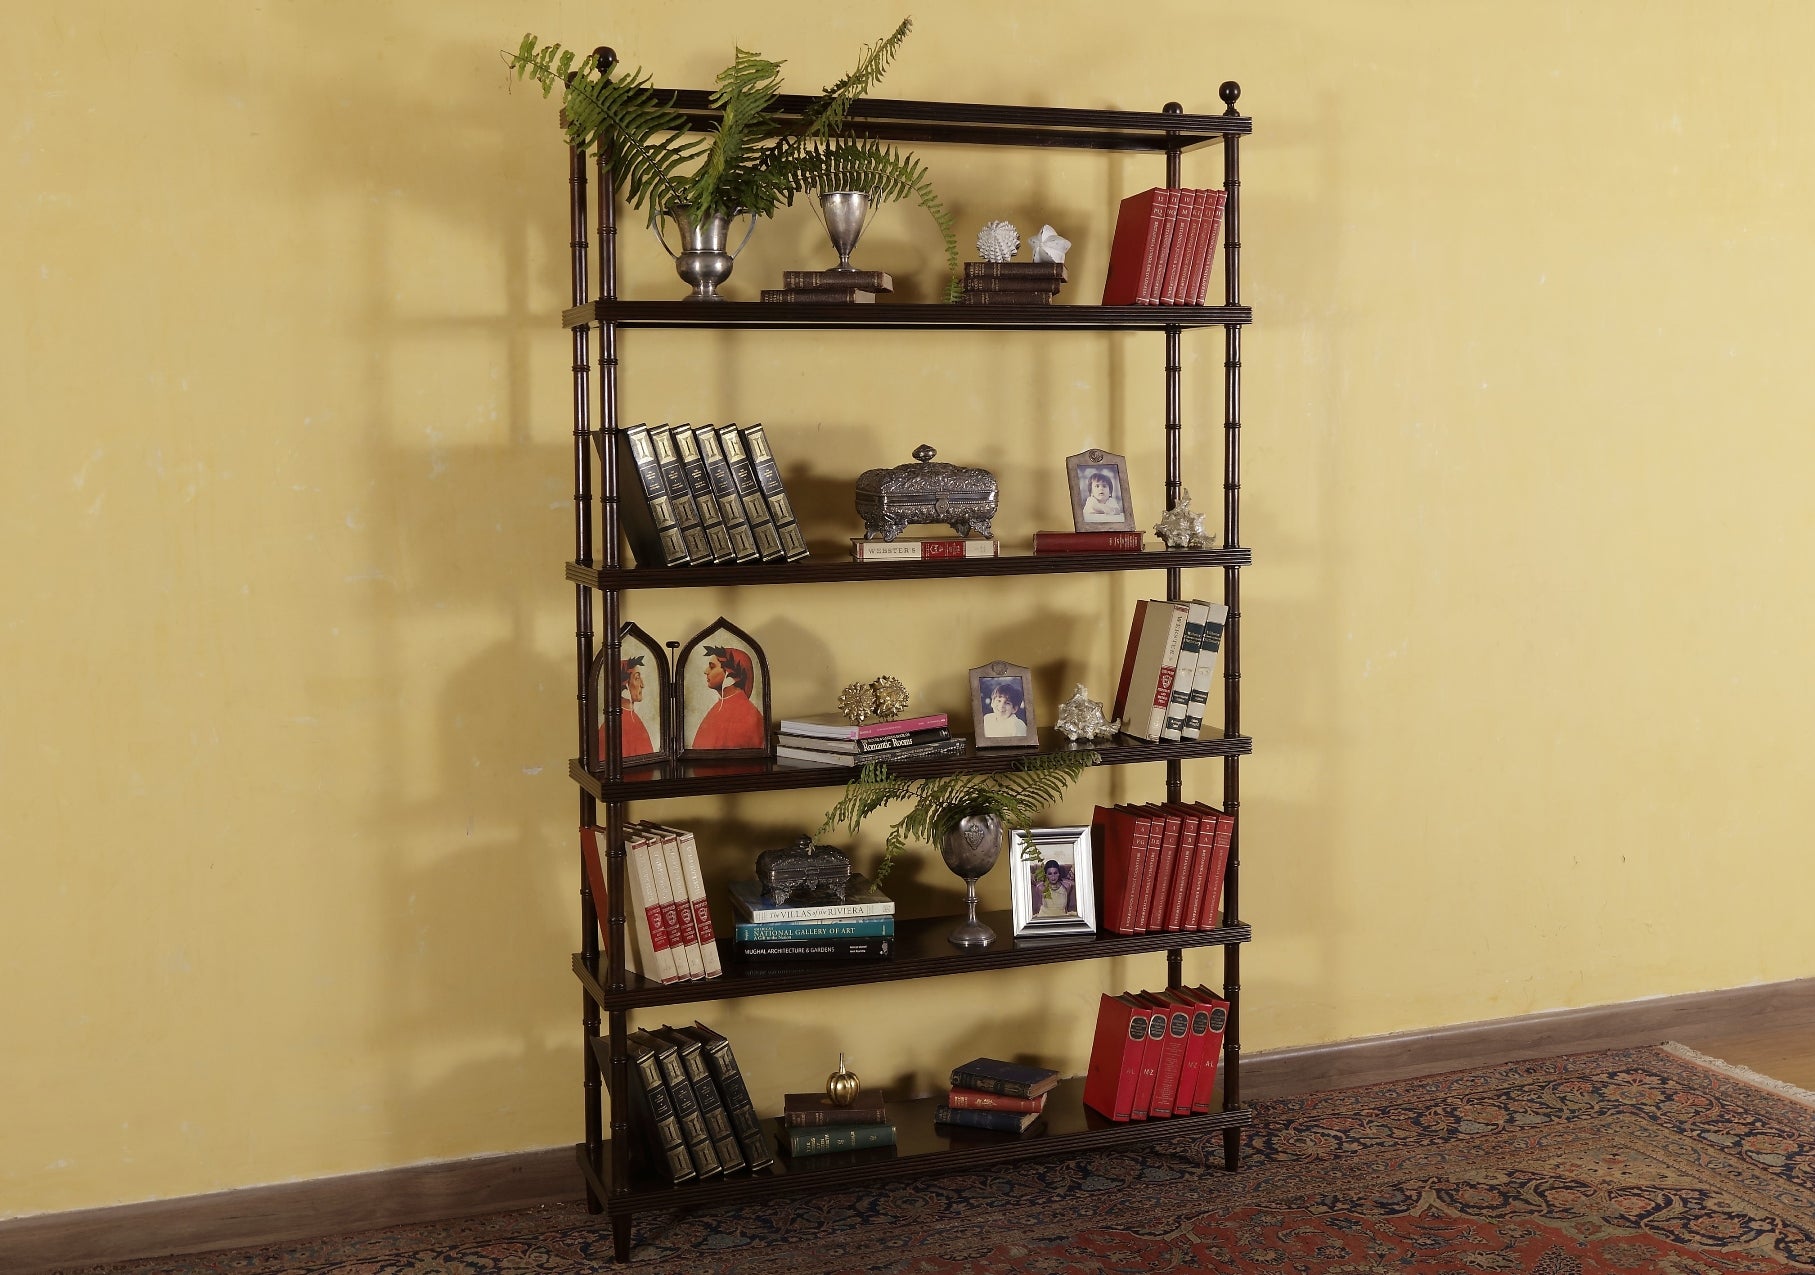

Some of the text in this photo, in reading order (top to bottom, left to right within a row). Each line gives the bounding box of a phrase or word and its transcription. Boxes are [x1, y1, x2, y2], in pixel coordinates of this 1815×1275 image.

[862, 741, 891, 752] Romantic
[892, 738, 913, 747] Rooms
[780, 910, 811, 918] VILLAS
[828, 906, 864, 916] RIVIERA
